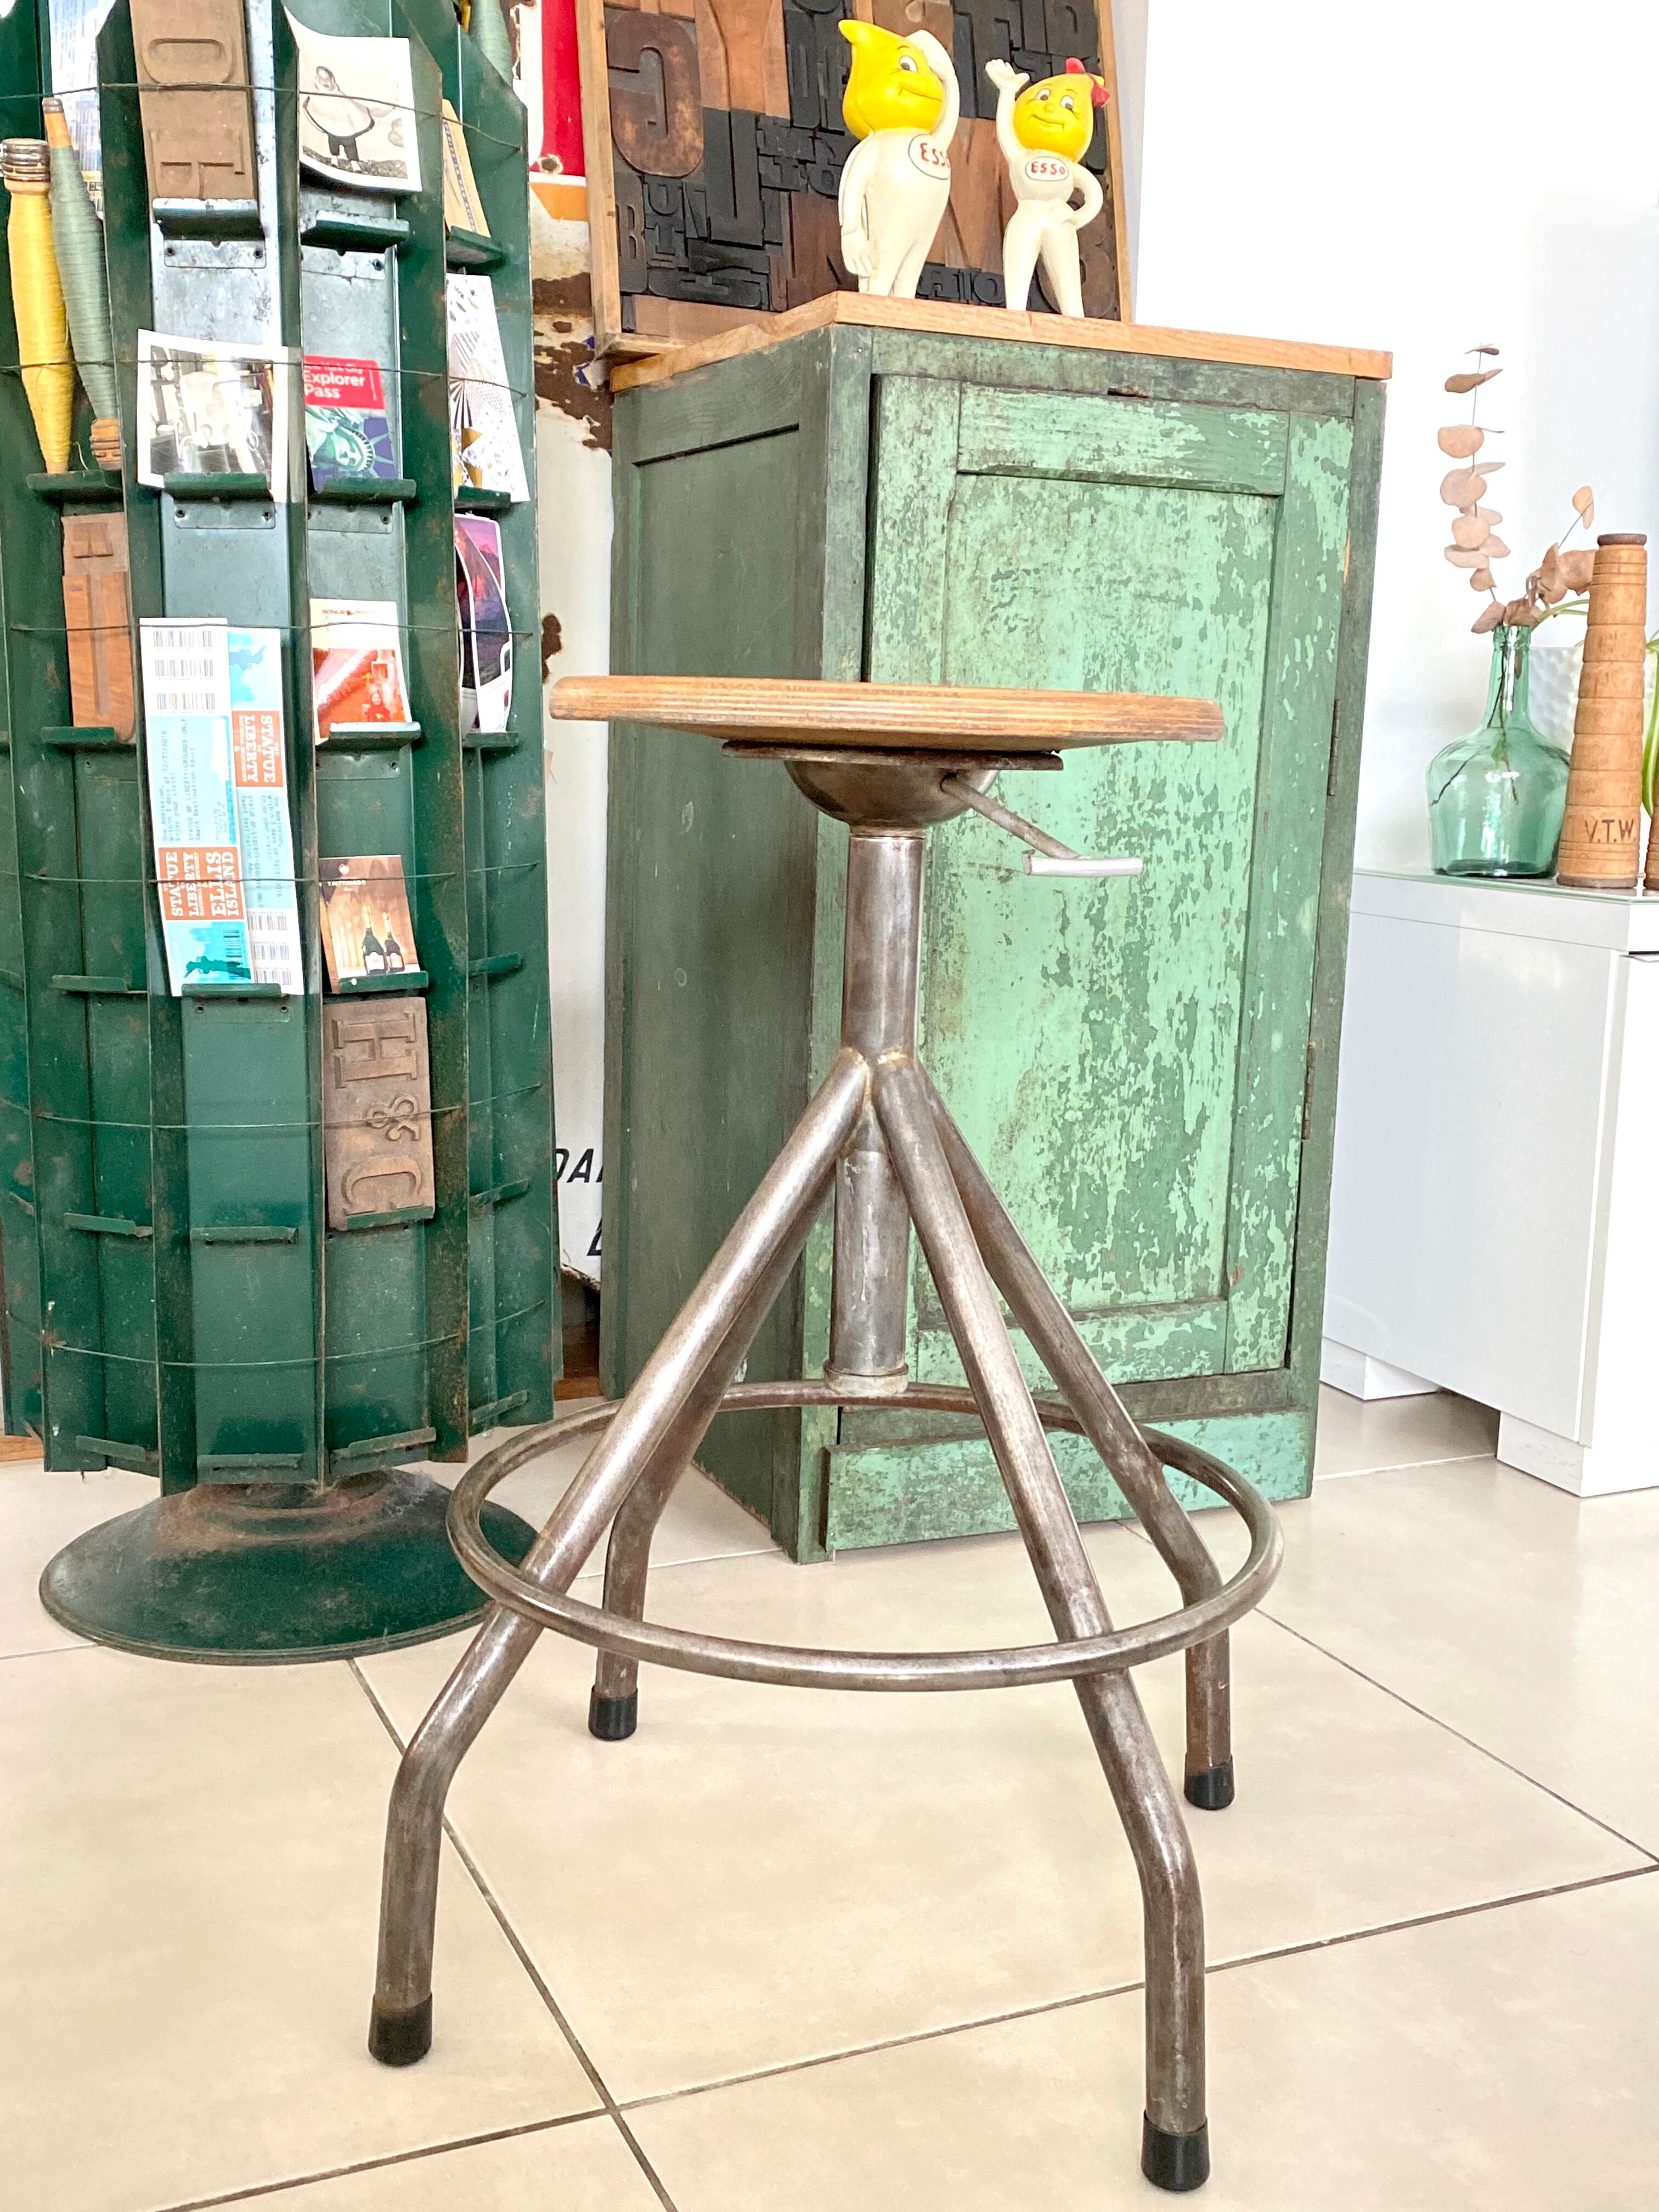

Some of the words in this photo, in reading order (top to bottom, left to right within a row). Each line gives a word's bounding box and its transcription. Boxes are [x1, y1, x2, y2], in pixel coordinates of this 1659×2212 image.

[1030, 161, 1066, 176] ESSO
[303, 369, 365, 387] Explorer
[304, 383, 341, 399] Pass
[245, 715, 258, 782] LIBERTY
[261, 715, 275, 782] STATUE
[185, 804, 191, 812] OF
[166, 851, 184, 916] STATUE
[183, 851, 199, 916] LIBERTY
[206, 851, 226, 916] ELLIS
[222, 851, 239, 916] ISLAND
